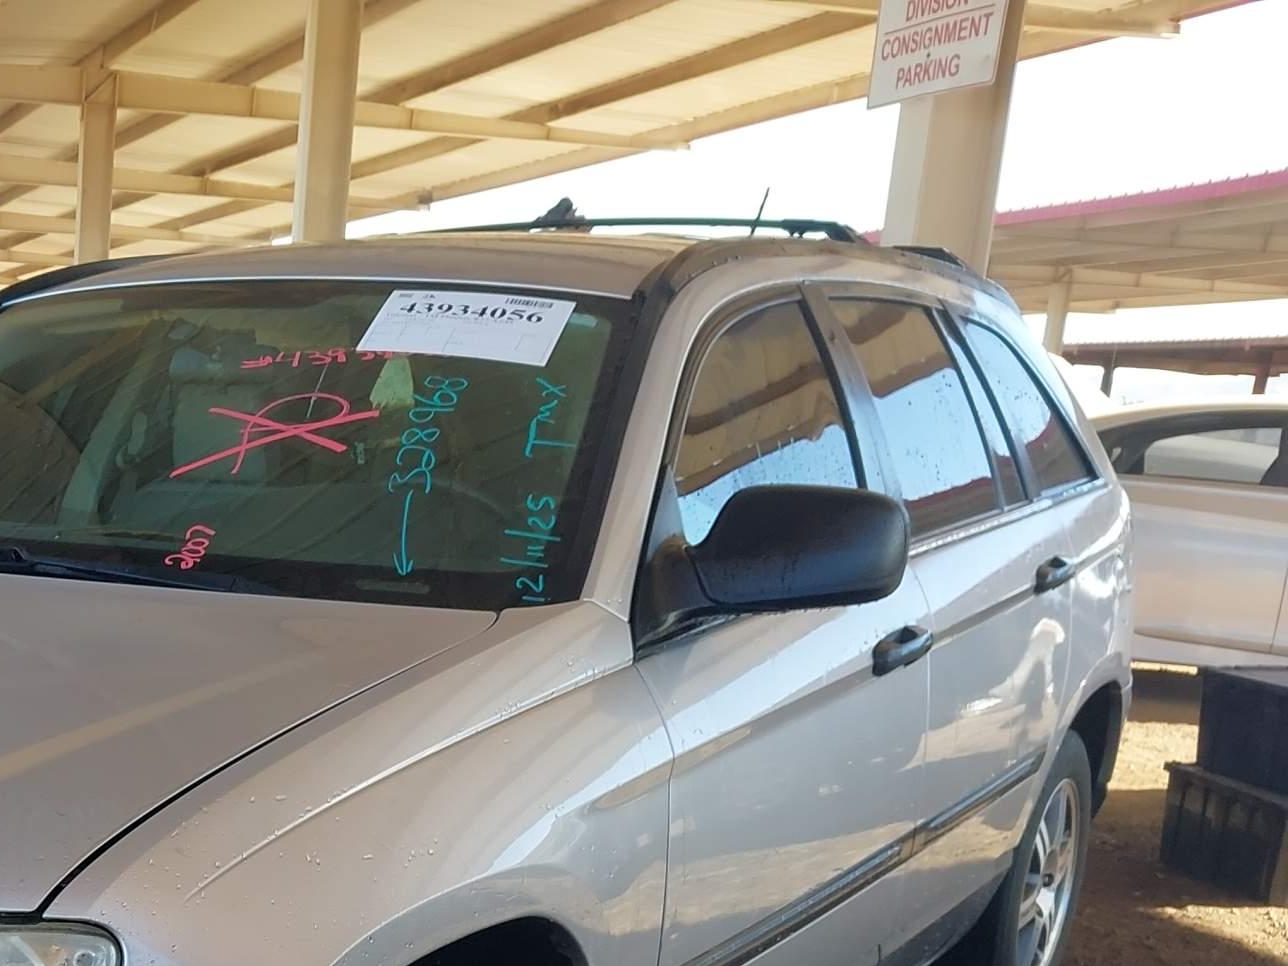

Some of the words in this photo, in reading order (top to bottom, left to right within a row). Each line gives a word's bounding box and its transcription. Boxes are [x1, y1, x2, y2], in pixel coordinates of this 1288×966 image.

[881, 12, 994, 61] CONSIGNMENT
[896, 54, 960, 90] PARKING
[400, 301, 543, 324] 43934056
